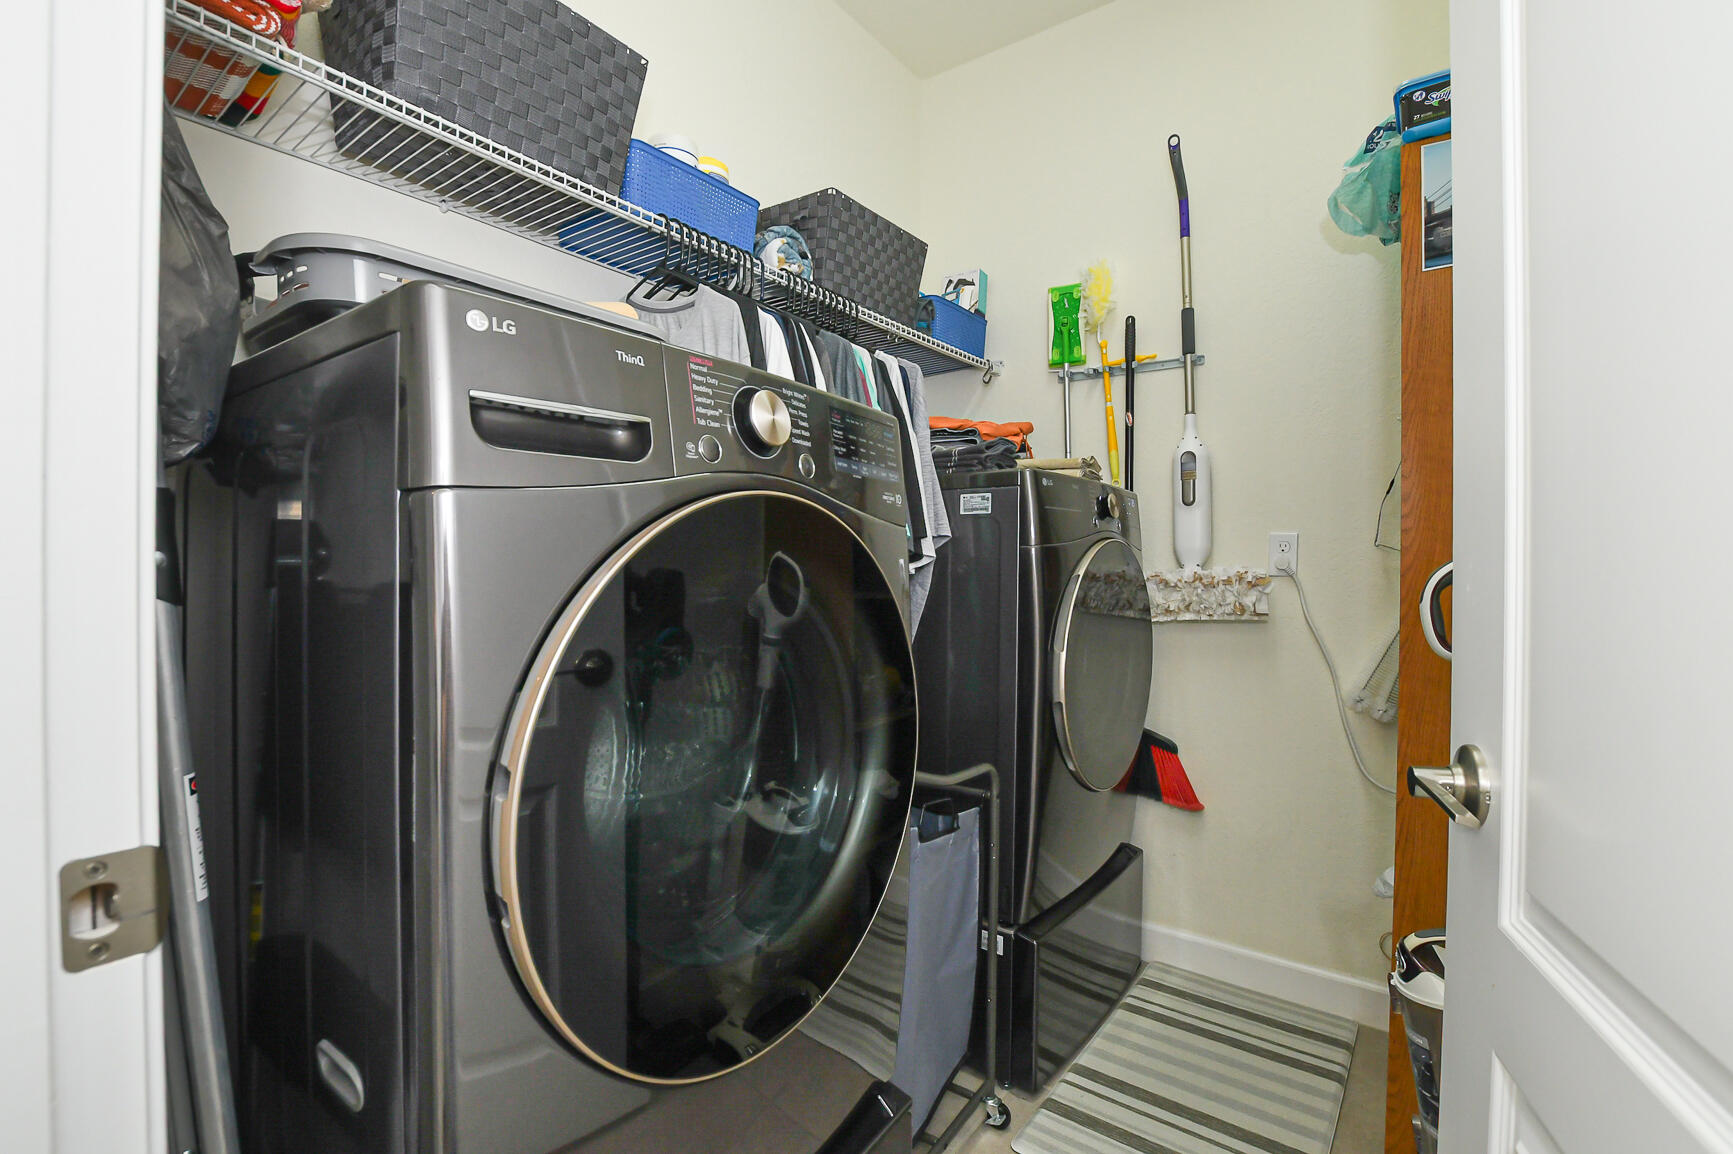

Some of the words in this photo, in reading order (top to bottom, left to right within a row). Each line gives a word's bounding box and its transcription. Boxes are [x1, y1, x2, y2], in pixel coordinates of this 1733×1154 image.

[492, 317, 516, 335] LG
[615, 350, 646, 367] ThinQ
[689, 362, 708, 373] Normal
[691, 372, 706, 383] Heavy
[707, 376, 719, 387] Duty
[692, 383, 713, 396] Bedding
[693, 395, 715, 406] Sanitary
[696, 417, 706, 426] Tub
[706, 419, 720, 428] Clean
